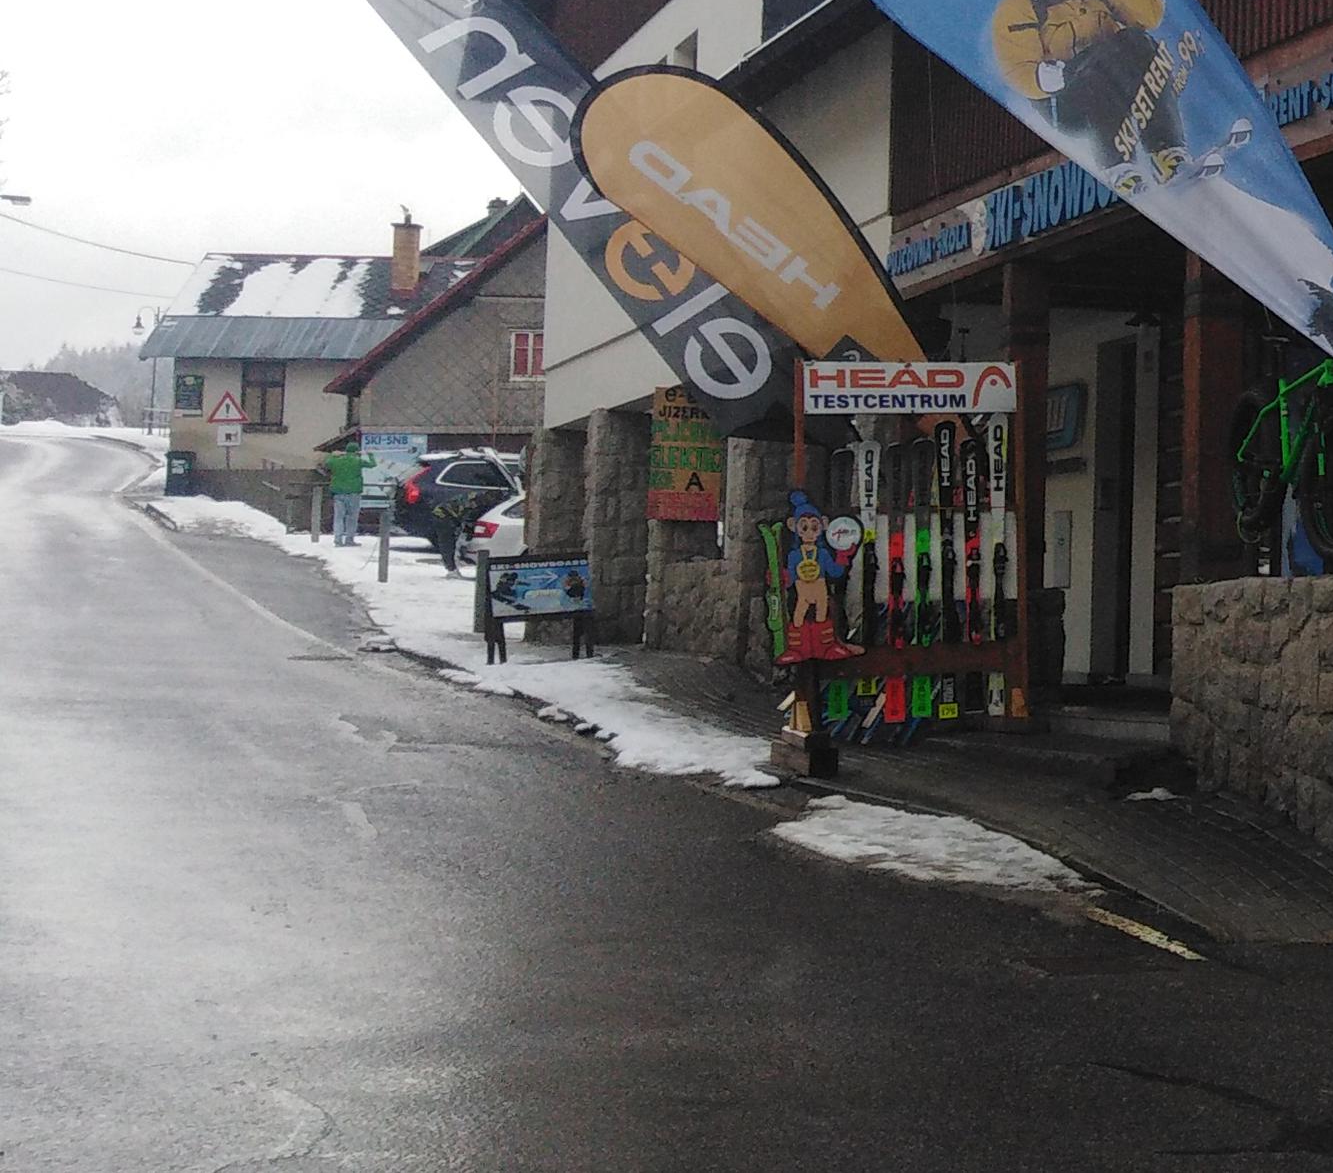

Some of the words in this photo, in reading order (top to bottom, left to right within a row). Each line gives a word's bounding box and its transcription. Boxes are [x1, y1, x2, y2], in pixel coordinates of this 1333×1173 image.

[1114, 117, 1138, 162] SKI
[1131, 84, 1156, 130] SET
[1144, 40, 1175, 99] RENT
[809, 368, 965, 388] HEAD
[810, 394, 966, 409] TESTCENTRUM
[865, 449, 874, 507] HEAD
[941, 428, 951, 487] HEAD
[994, 424, 1004, 491] HEAD
[966, 459, 977, 522] HEAD
